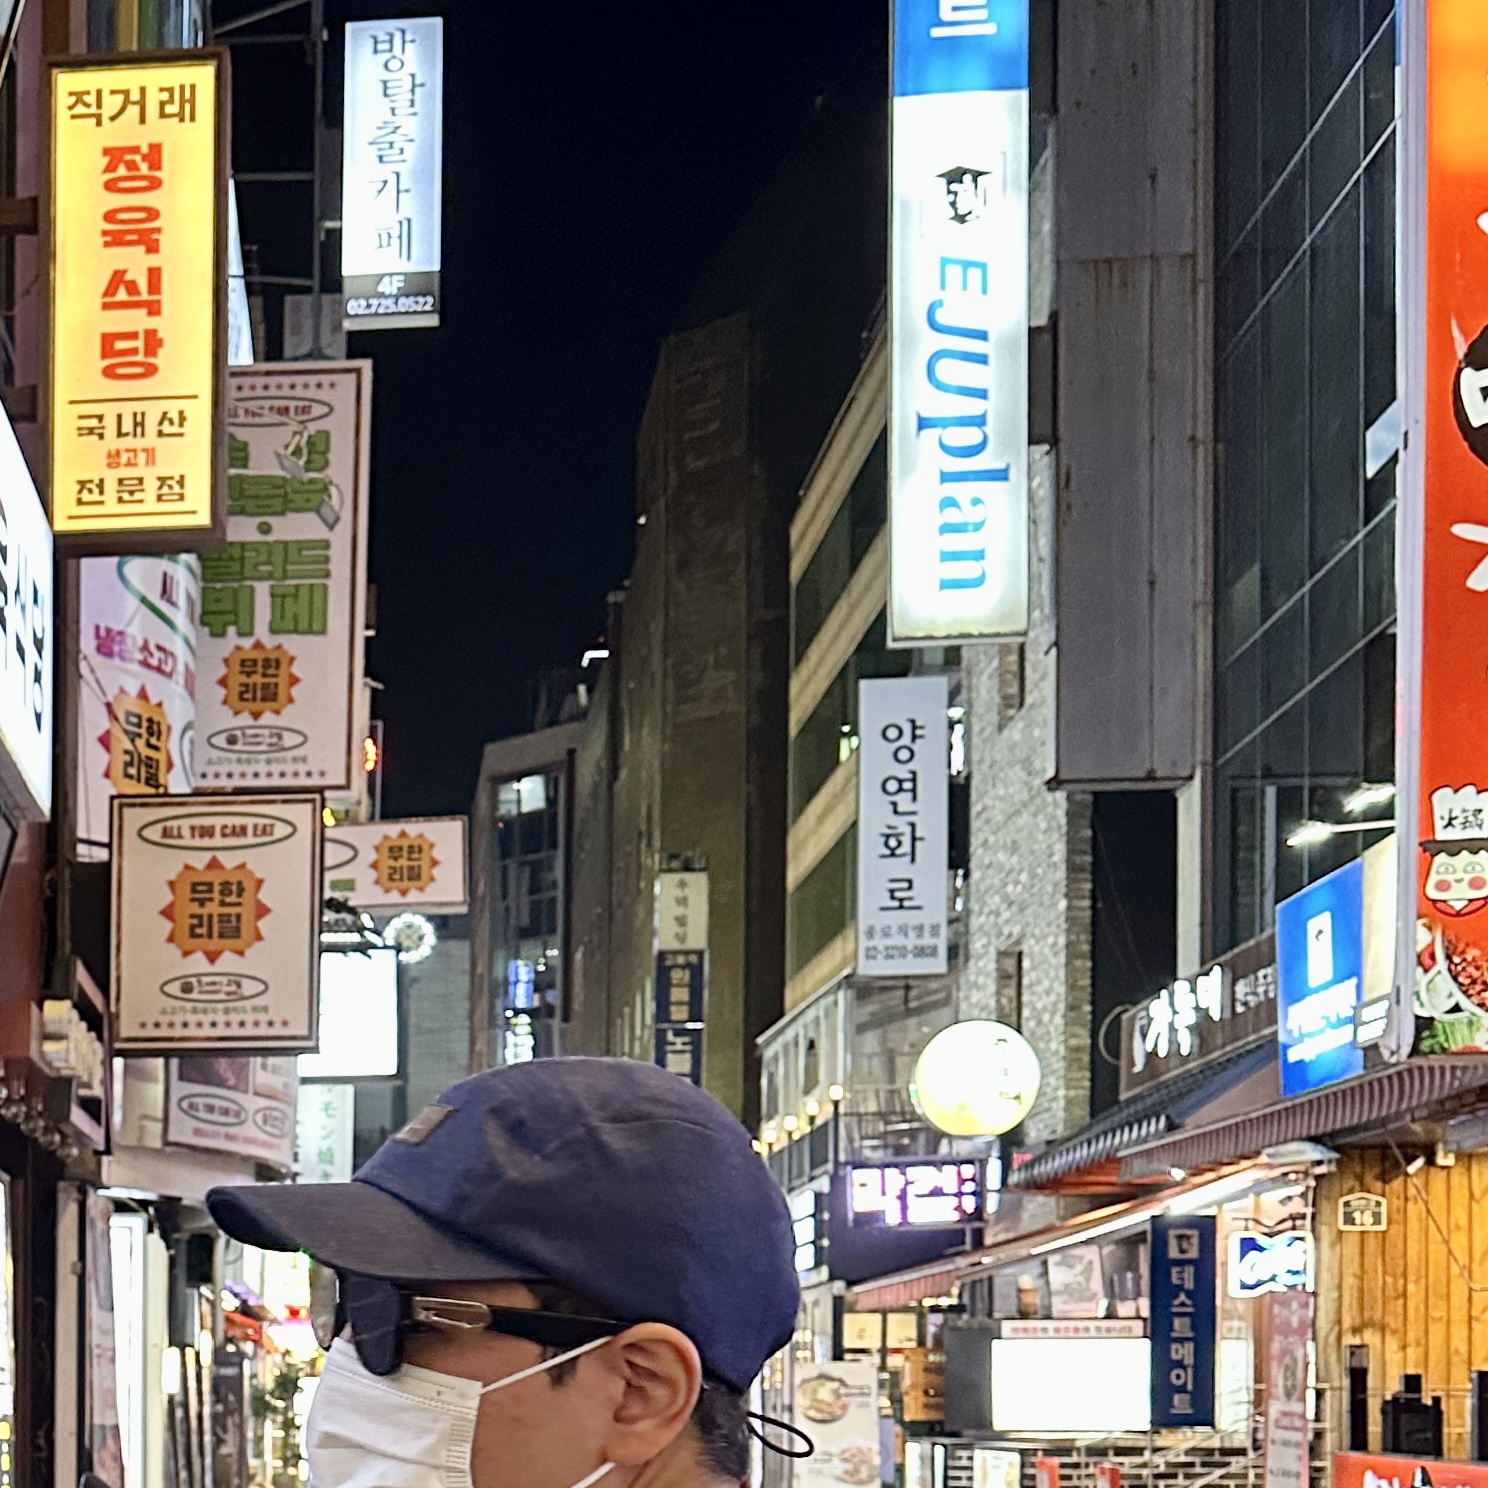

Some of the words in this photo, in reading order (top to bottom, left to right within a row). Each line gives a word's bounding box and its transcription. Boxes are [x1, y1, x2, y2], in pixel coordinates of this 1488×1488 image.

[66, 83, 197, 127] 직거래
[100, 142, 164, 381] 정육식당
[377, 274, 405, 295] 4F
[76, 410, 187, 441] 국내산
[916, 256, 1010, 592] EJUplan
[106, 447, 156, 469] 생고기
[76, 474, 185, 506] 전문점
[201, 583, 328, 637] 뷔페
[239, 657, 281, 678] 무한
[239, 682, 279, 702] 리필
[124, 709, 162, 751] 무한
[122, 749, 162, 793] 리필
[879, 718, 926, 911] 양연화로
[160, 826, 184, 839] ALL
[189, 824, 215, 839] YOU
[220, 824, 247, 838] CAN
[252, 823, 275, 837] EAT
[387, 844, 422, 863] 무한
[189, 880, 245, 907] 무한
[188, 913, 242, 939] 리필
[1352, 1209, 1375, 1226] 16
[1169, 1264, 1195, 1415] 테스트메이트
